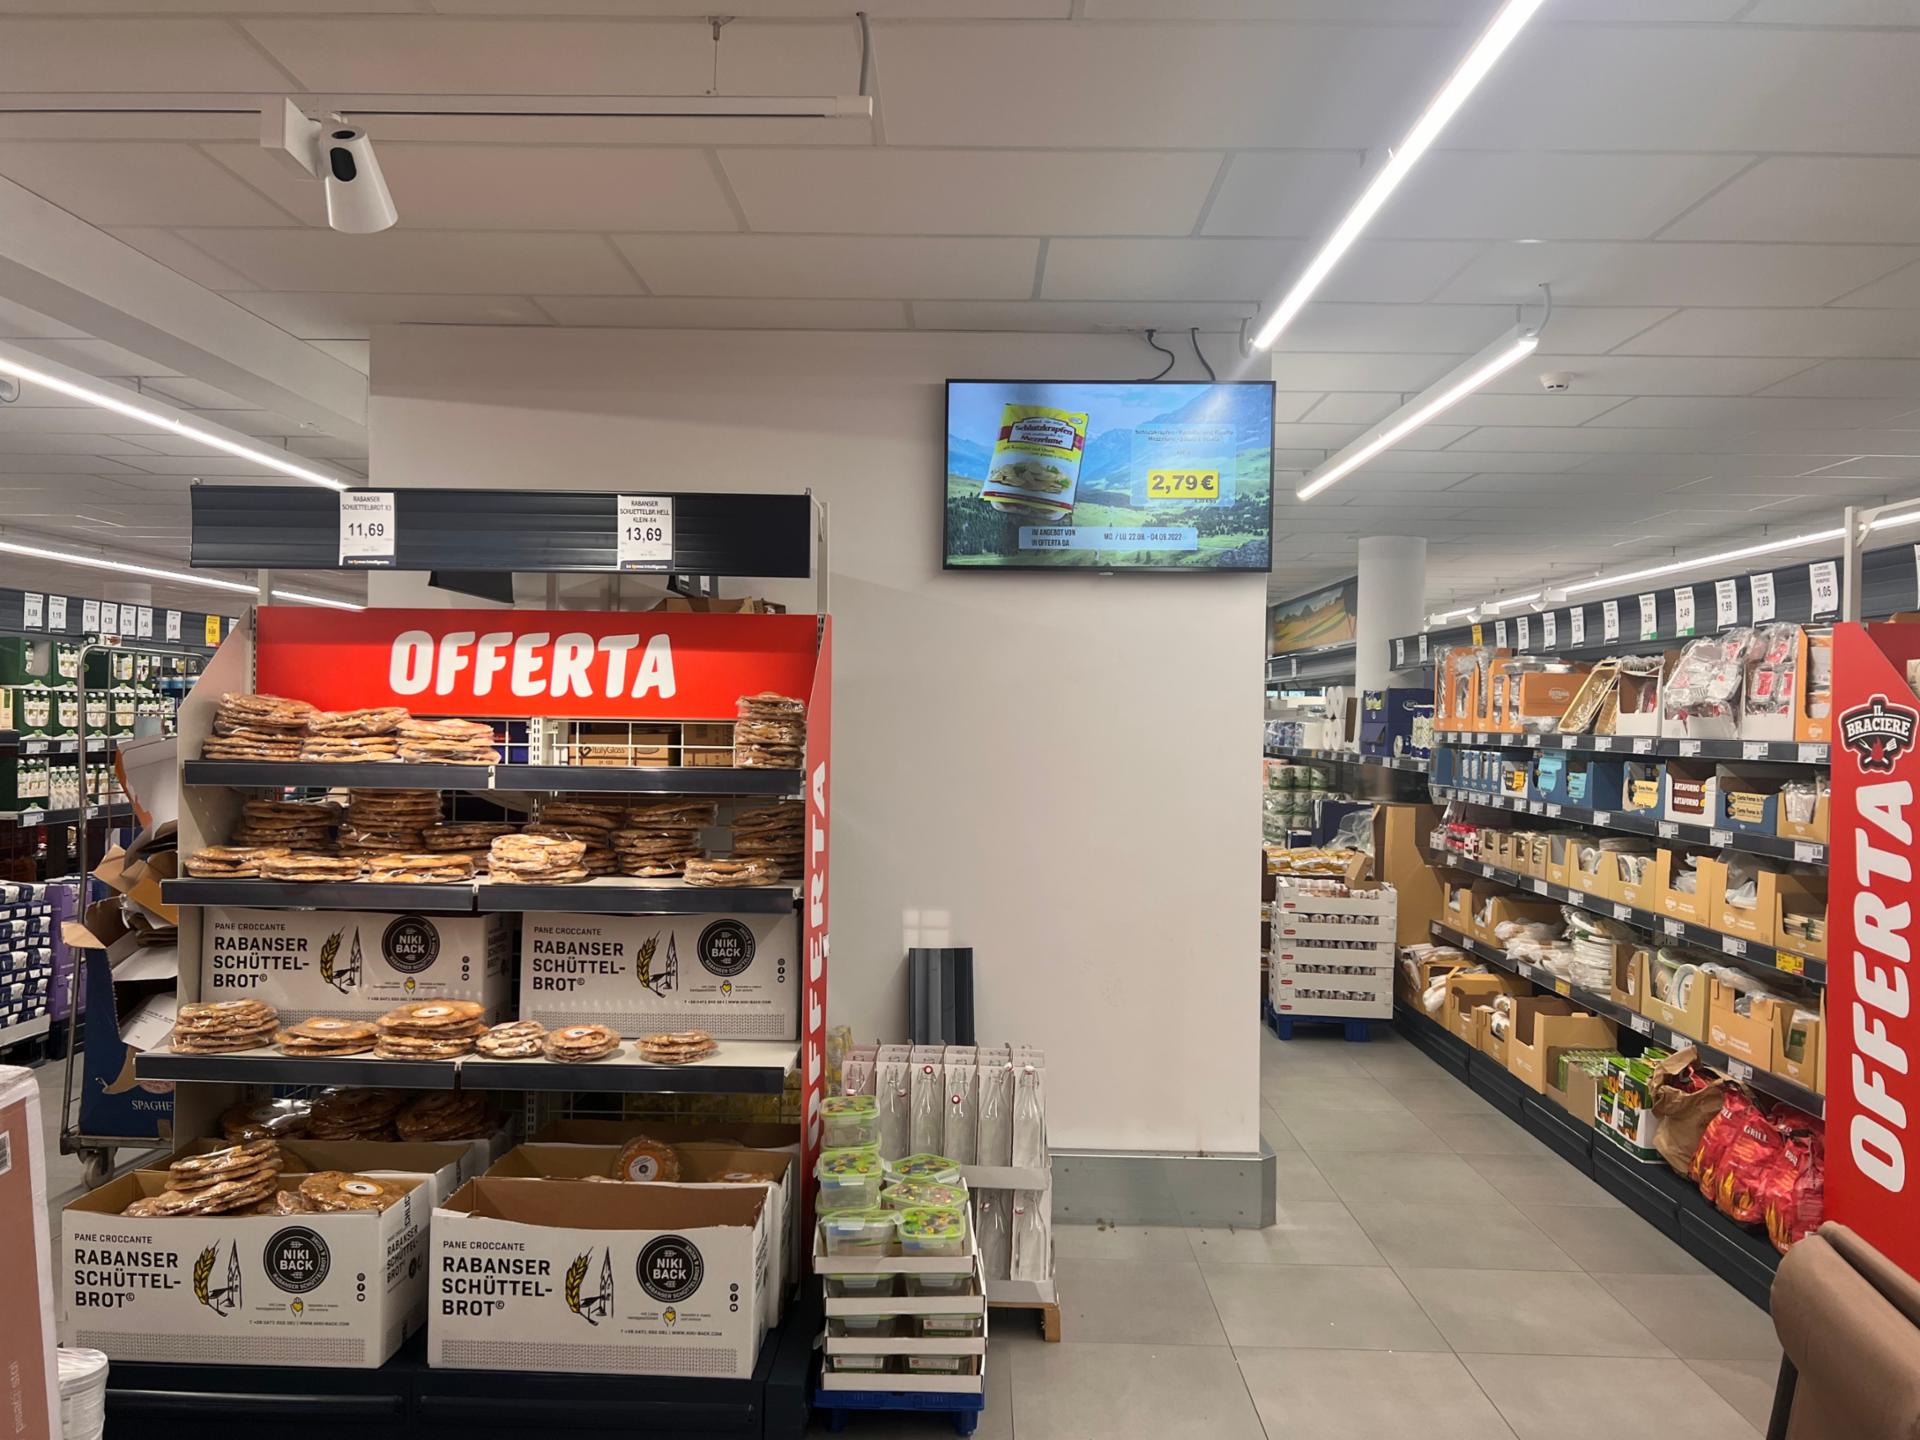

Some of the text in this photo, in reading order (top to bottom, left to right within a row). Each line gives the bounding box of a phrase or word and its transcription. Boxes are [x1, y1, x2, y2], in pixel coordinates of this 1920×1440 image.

[353, 495, 381, 503] RABANSER
[348, 522, 385, 539] 11,69
[625, 526, 662, 543] 13,69
[1039, 528, 1064, 536] ANGEBOT
[1038, 539, 1062, 547] OFFERTA
[1817, 585, 1832, 598] 1,05
[389, 630, 677, 699] OFFERTA
[1873, 705, 1884, 716] IL
[1846, 717, 1911, 738] BRACIERE
[215, 922, 286, 932] PANE CROCCANTE
[533, 926, 601, 936] PANE CROCCANTE
[214, 936, 308, 952] RABANSER
[399, 935, 422, 944] NIKI
[714, 938, 737, 948] NIKI
[396, 944, 425, 954] BACK
[533, 940, 624, 956] RABANSER
[711, 948, 741, 957] BACK
[213, 952, 310, 971] SCHÜTTEL-
[808, 760, 826, 1152] OFFERTA
[532, 957, 626, 974] SCHÜTTEL-
[1850, 781, 1913, 1193] OFFERTA
[1743, 1124, 1769, 1143] GRILL
[74, 1233, 153, 1245] PANE CROCCANTE
[442, 1240, 525, 1251] PANE CROCCANTE
[74, 1248, 179, 1269] RABANSER
[283, 1249, 310, 1260] NIKI
[279, 1260, 313, 1270] BACK
[442, 1256, 550, 1276] RABANSER
[656, 1258, 683, 1269] NIKI
[74, 1268, 182, 1289] SCHÜTTEL-
[652, 1269, 687, 1280] BACK
[442, 1275, 553, 1297] SCHÜTTEL-
